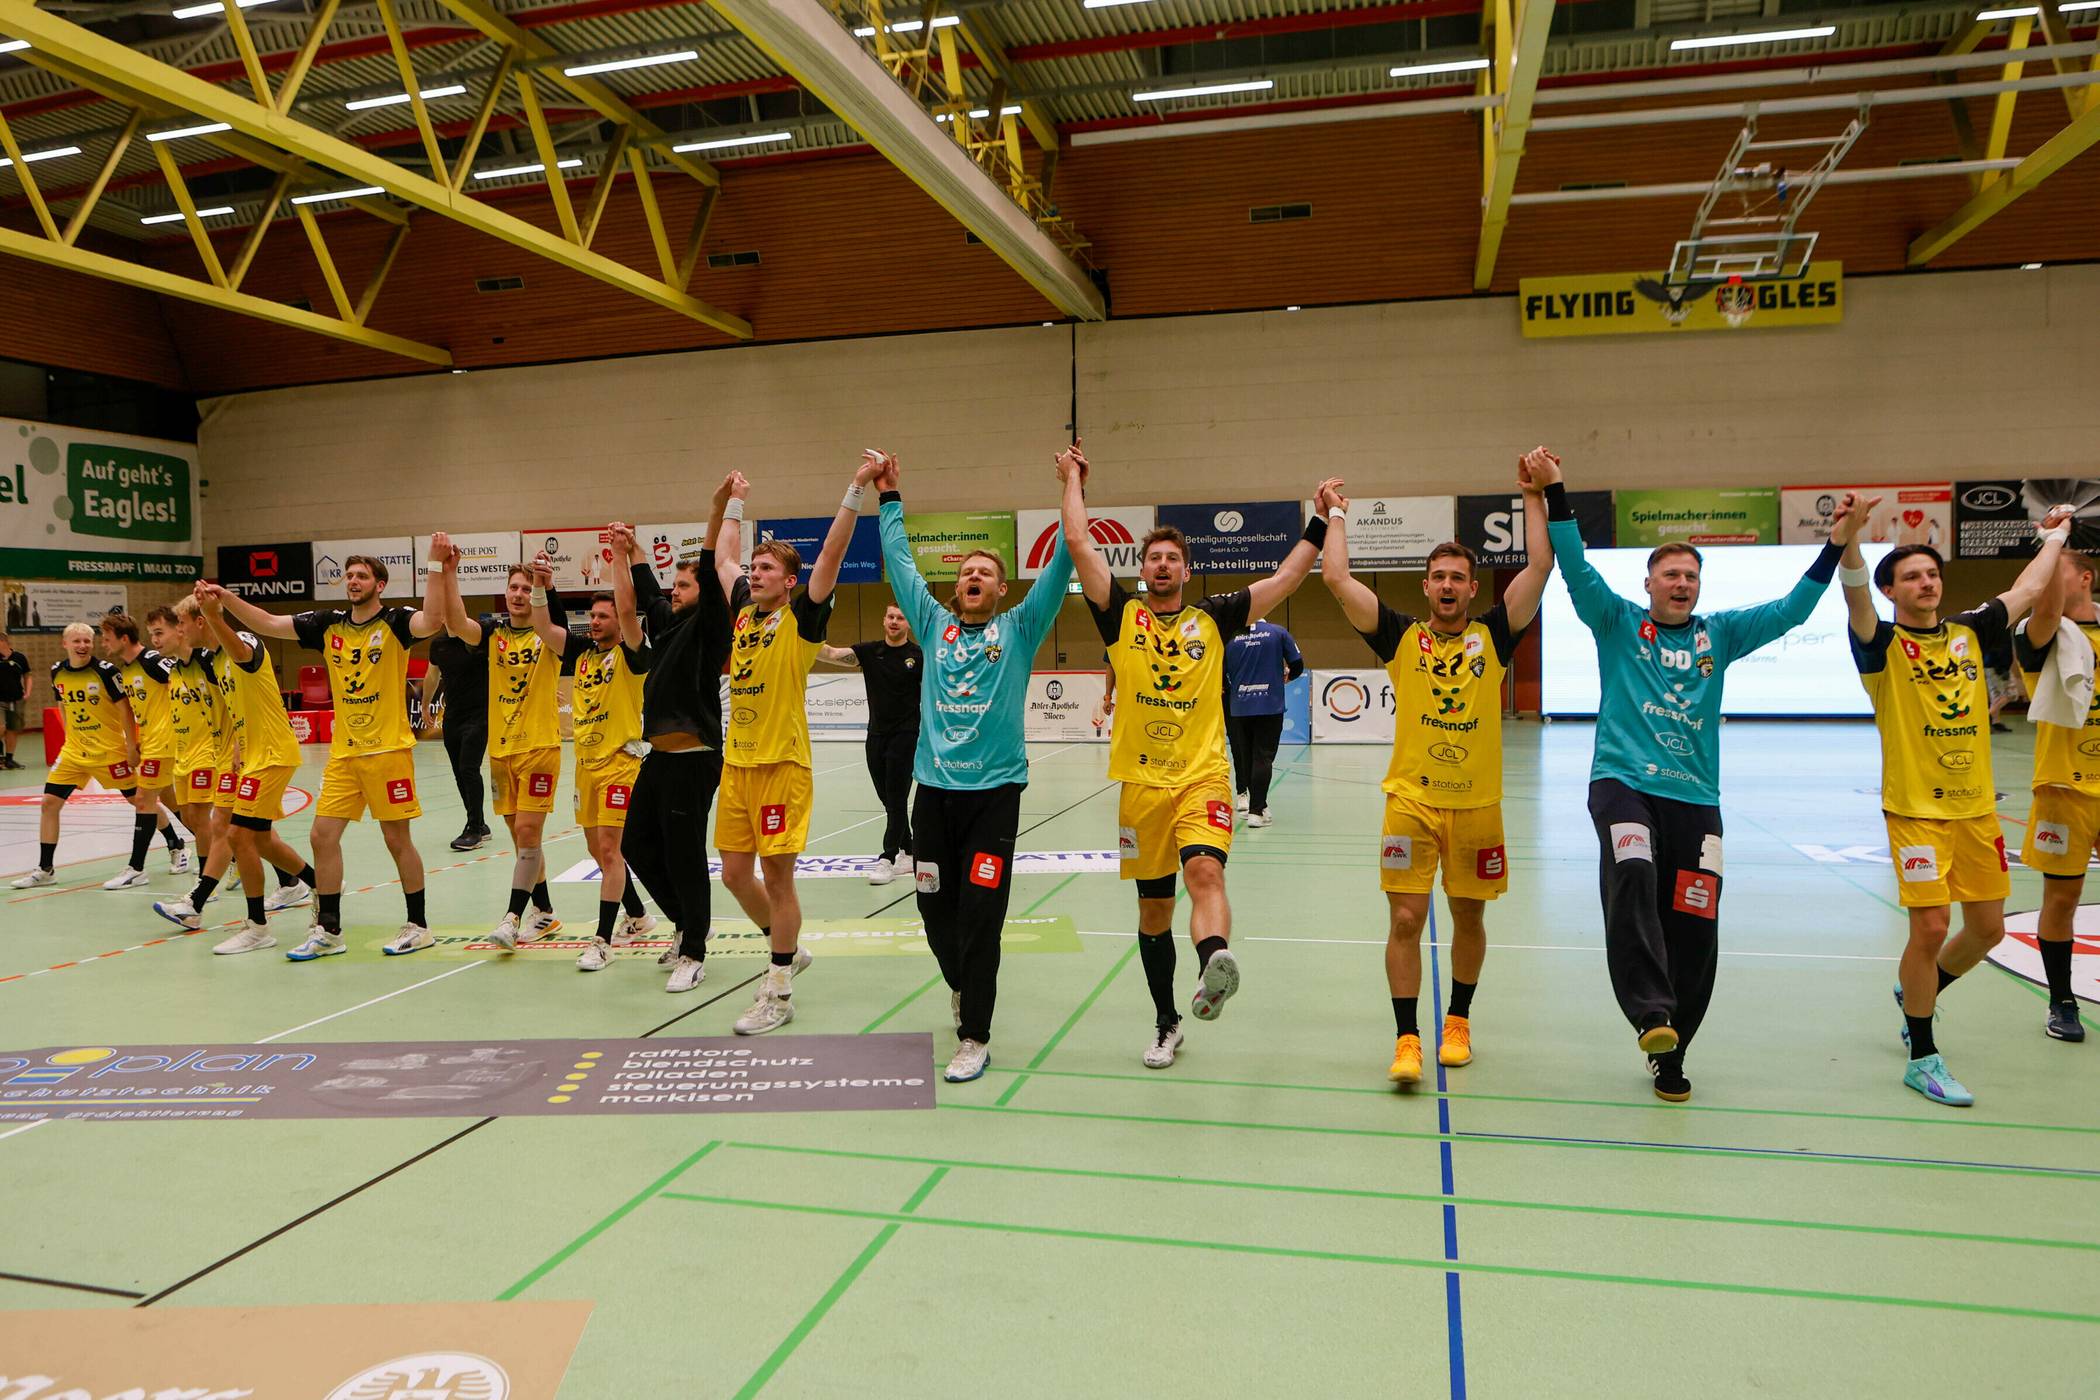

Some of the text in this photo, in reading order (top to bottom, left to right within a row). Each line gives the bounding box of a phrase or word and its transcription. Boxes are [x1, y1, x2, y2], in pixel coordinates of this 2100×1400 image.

[1526, 291, 1635, 320] FLYING
[82, 459, 173, 488] Auf geht's
[1973, 491, 2003, 505] JCL
[83, 489, 178, 528] Eagles!
[1356, 517, 1404, 526] AKANDUS
[1632, 510, 1747, 524] Spielmacher:innen
[1482, 498, 1525, 553] si
[908, 532, 989, 543] ielmacher:innen
[1185, 533, 1288, 545] Beteiligungsgesellschaft
[478, 546, 498, 556] POST
[377, 554, 412, 565] STÄTTE
[843, 561, 877, 570] Dein Weg.
[1476, 554, 1527, 565] LK-WERB
[68, 560, 136, 574] FRESSNAPF
[143, 563, 173, 575] MAXI
[463, 565, 479, 574] DES
[480, 563, 512, 574] WESTEN
[225, 580, 305, 597] STANNO
[350, 648, 361, 665] 3
[507, 648, 534, 666] 33
[1431, 651, 1464, 678] 27
[67, 689, 86, 703] 19
[1136, 692, 1198, 711] fressnapf
[1379, 685, 1397, 715] fy
[936, 699, 993, 716] fressnapf
[1421, 713, 1479, 734] fressnapf
[1153, 725, 1174, 737] JCL
[1665, 735, 1687, 752] JCL
[1438, 747, 1459, 760] JCL
[943, 760, 976, 769] station
[1150, 756, 1187, 768] station 3
[1431, 778, 1473, 790] station 3
[628, 1047, 753, 1059] raffstore
[622, 1055, 814, 1070] blendschutz
[613, 1069, 748, 1081] rolladen
[606, 1076, 926, 1093] steuerungssysteme
[599, 1091, 755, 1104] markisen
